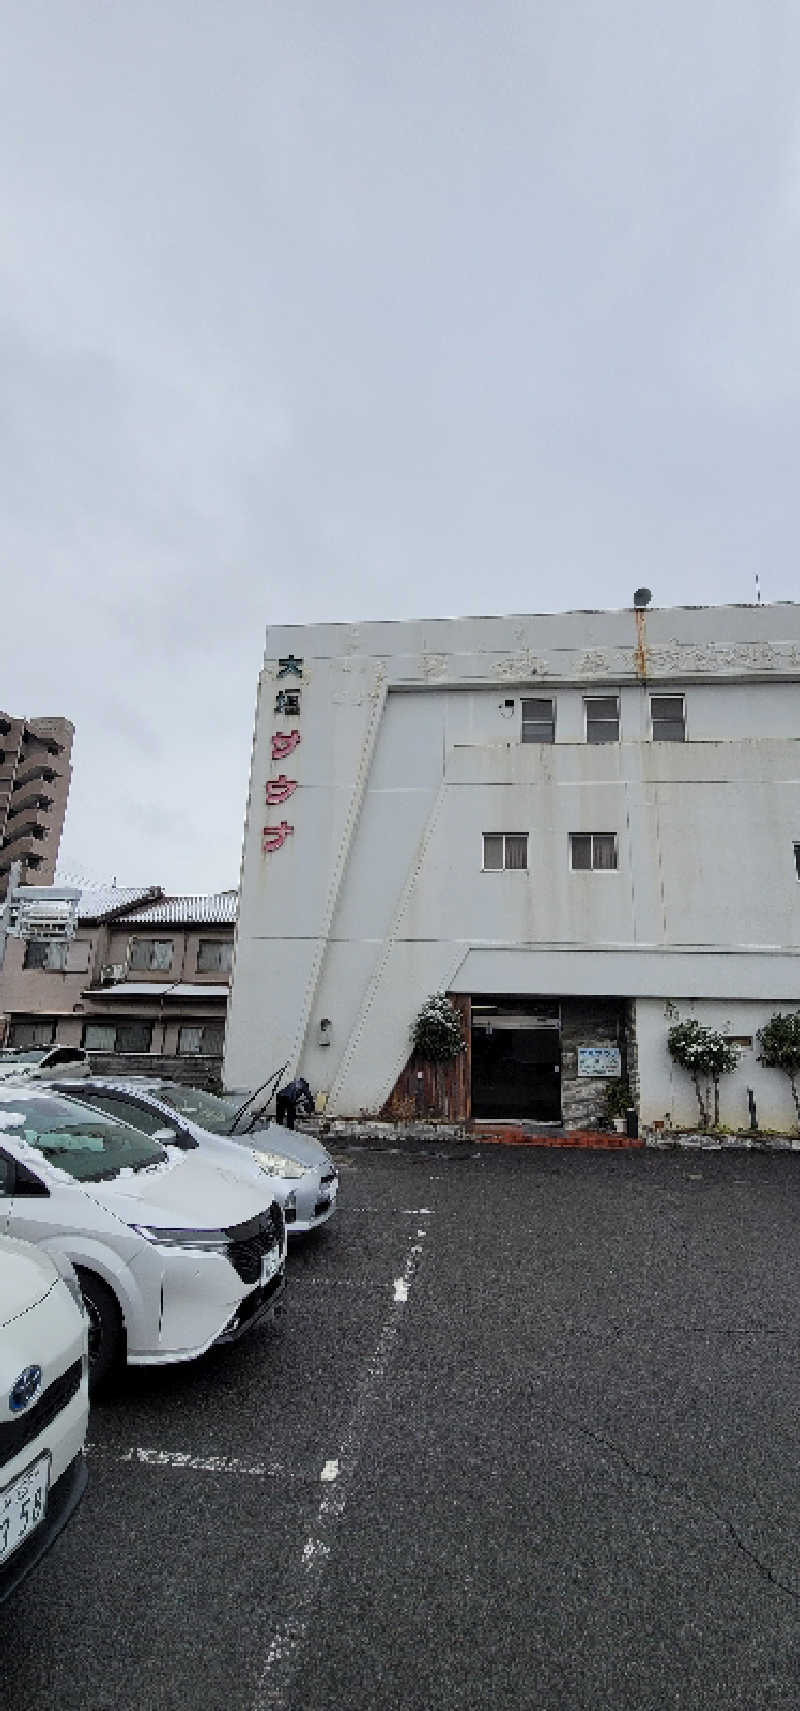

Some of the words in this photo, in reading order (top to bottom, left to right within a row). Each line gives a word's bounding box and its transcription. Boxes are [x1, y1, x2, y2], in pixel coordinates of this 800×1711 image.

[263, 655, 304, 852] 大垣サウナ
